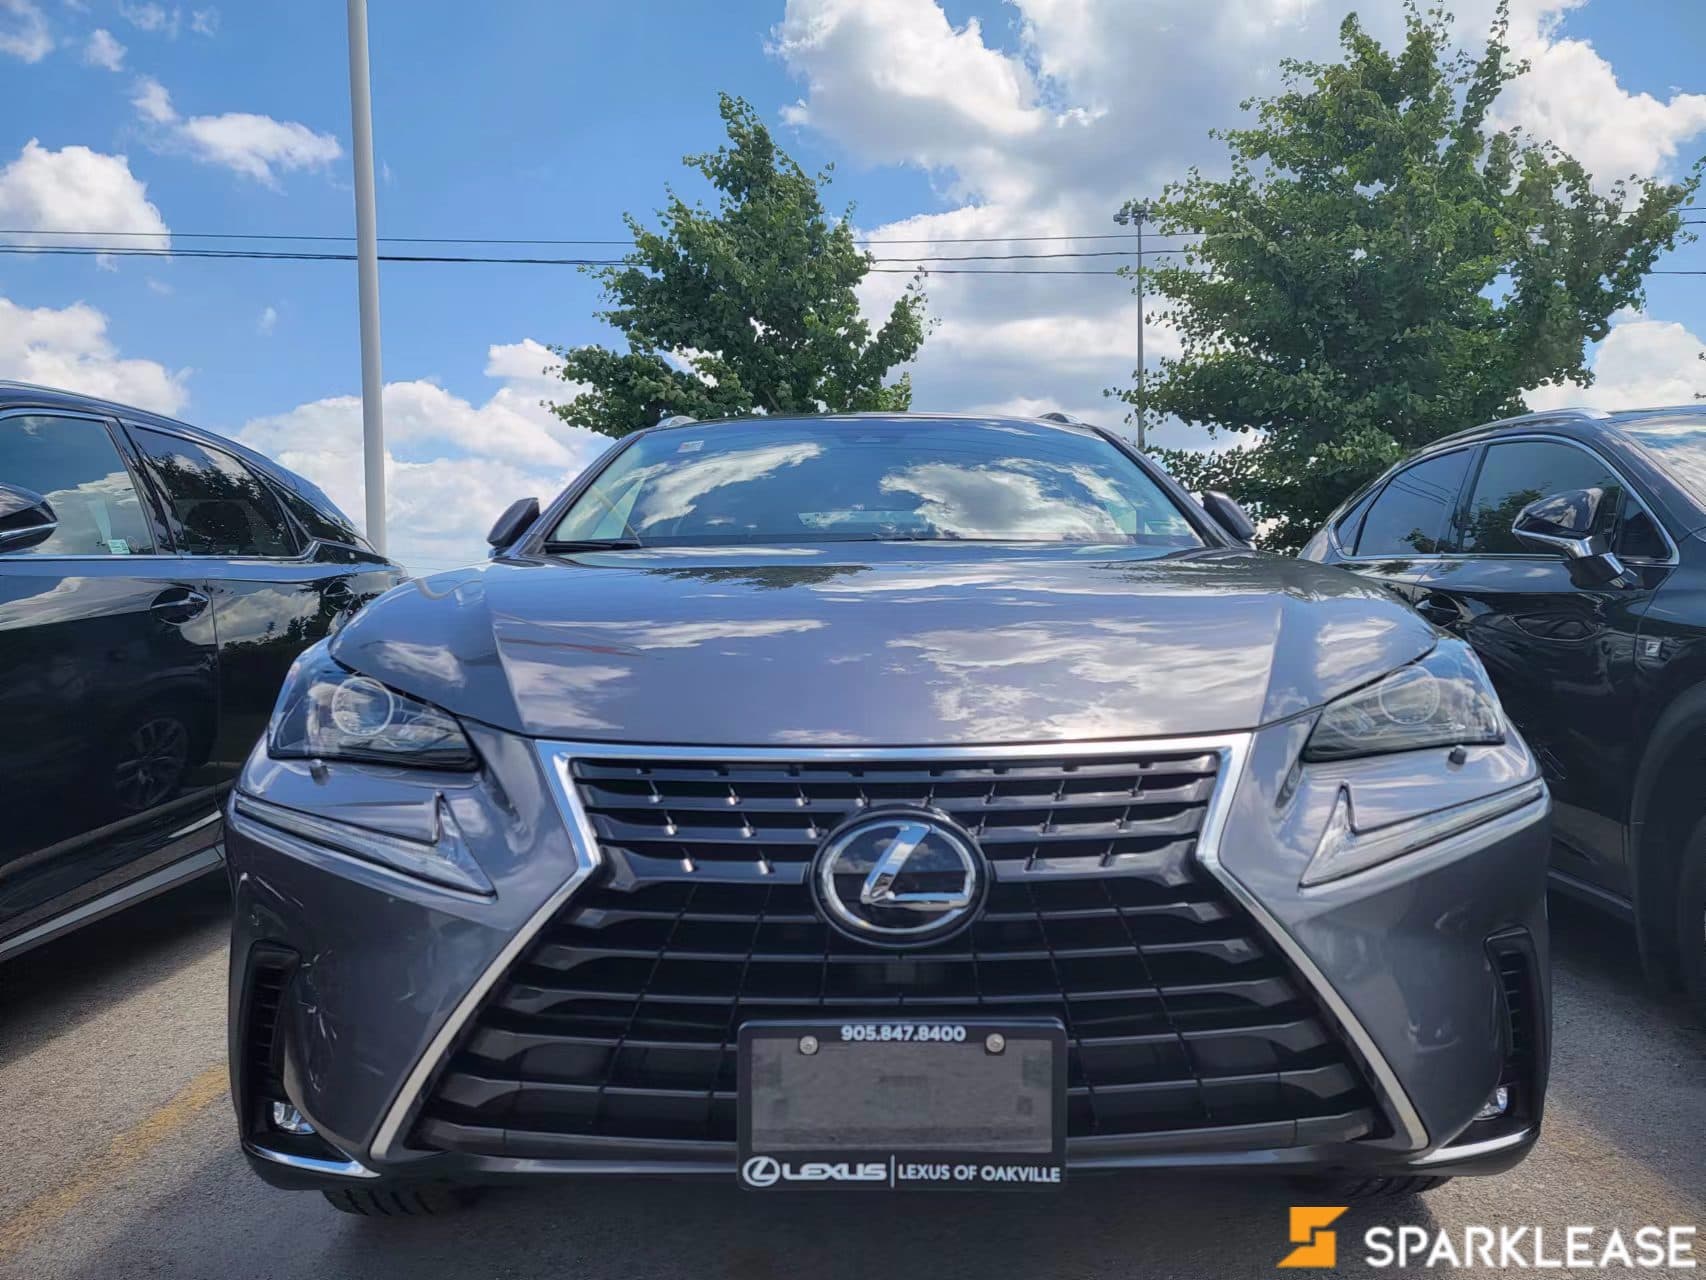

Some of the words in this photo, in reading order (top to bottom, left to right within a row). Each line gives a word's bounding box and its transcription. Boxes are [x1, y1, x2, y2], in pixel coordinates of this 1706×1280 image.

[841, 1025, 966, 1041] 905.847.8400
[783, 1163, 887, 1180] LEXUS
[899, 1164, 949, 1180] LEXUS
[954, 1165, 977, 1181] OF
[981, 1166, 1060, 1182] OAKVILLE
